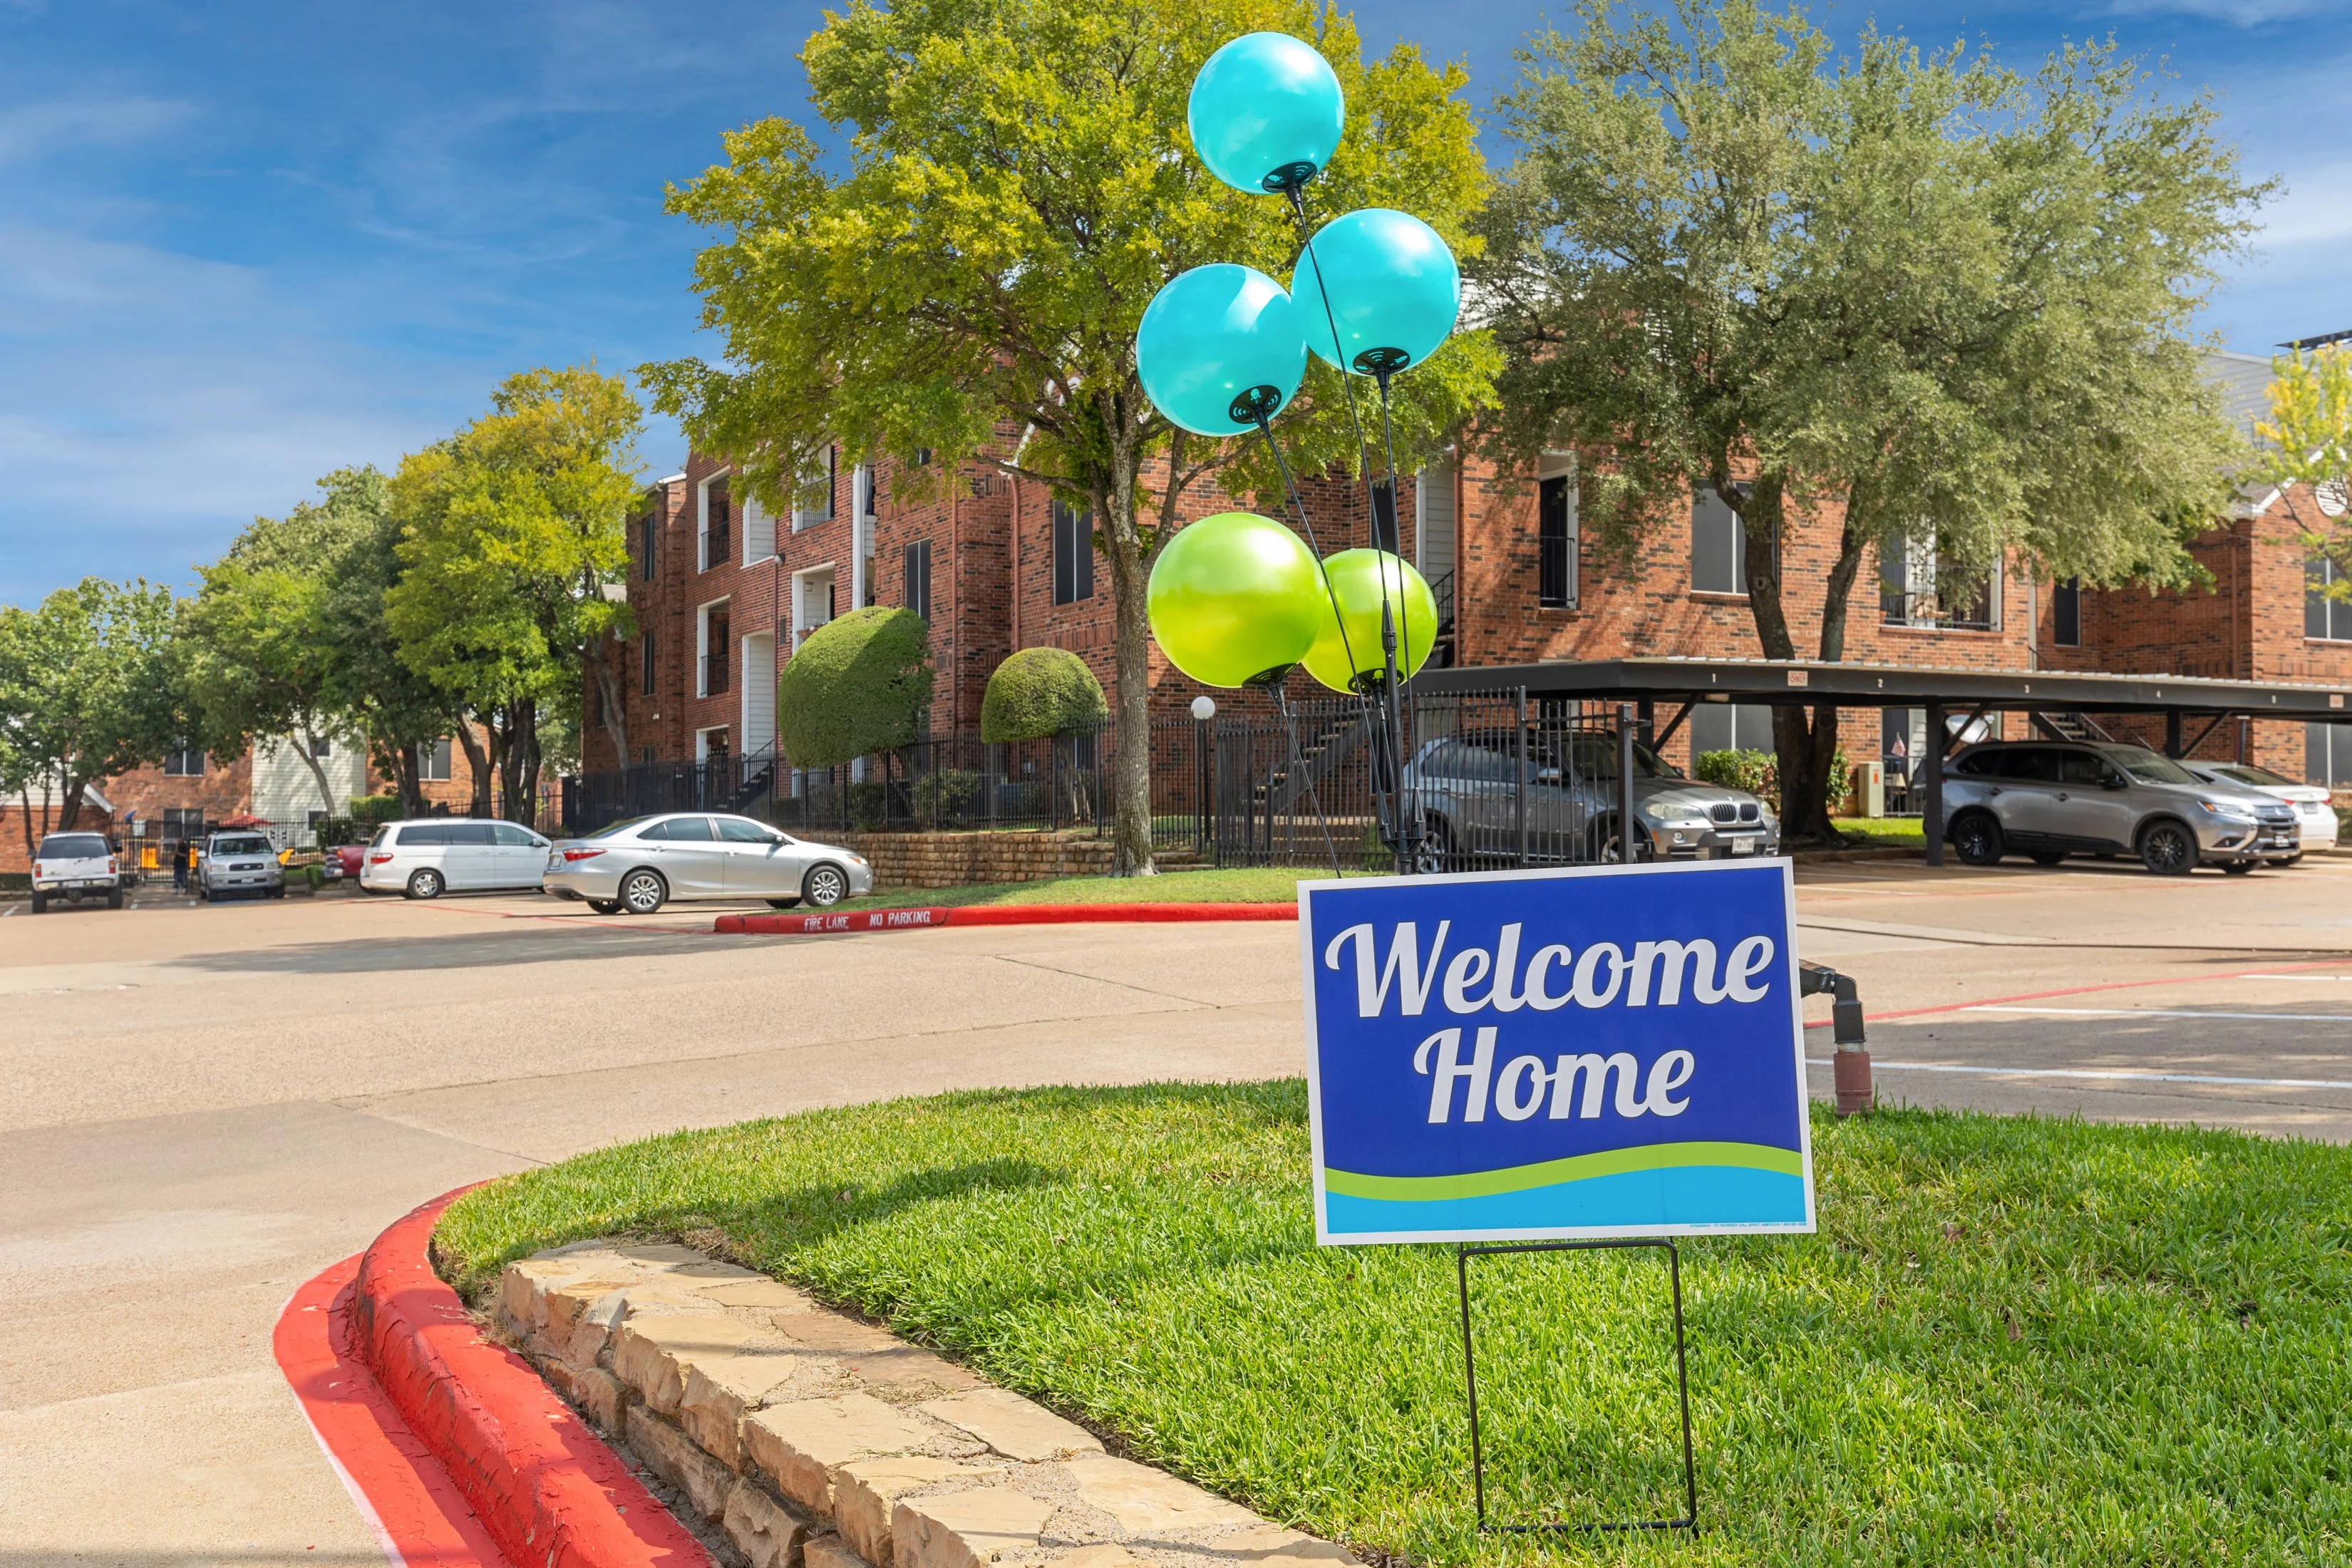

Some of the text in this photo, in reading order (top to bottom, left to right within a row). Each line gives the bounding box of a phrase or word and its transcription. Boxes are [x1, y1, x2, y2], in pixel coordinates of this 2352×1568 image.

[1877, 678, 1883, 688] 2
[804, 910, 931, 932] FIRE LANE NO PARKING
[1324, 919, 1775, 1018] Welcome
[1413, 1026, 1695, 1124] Home
